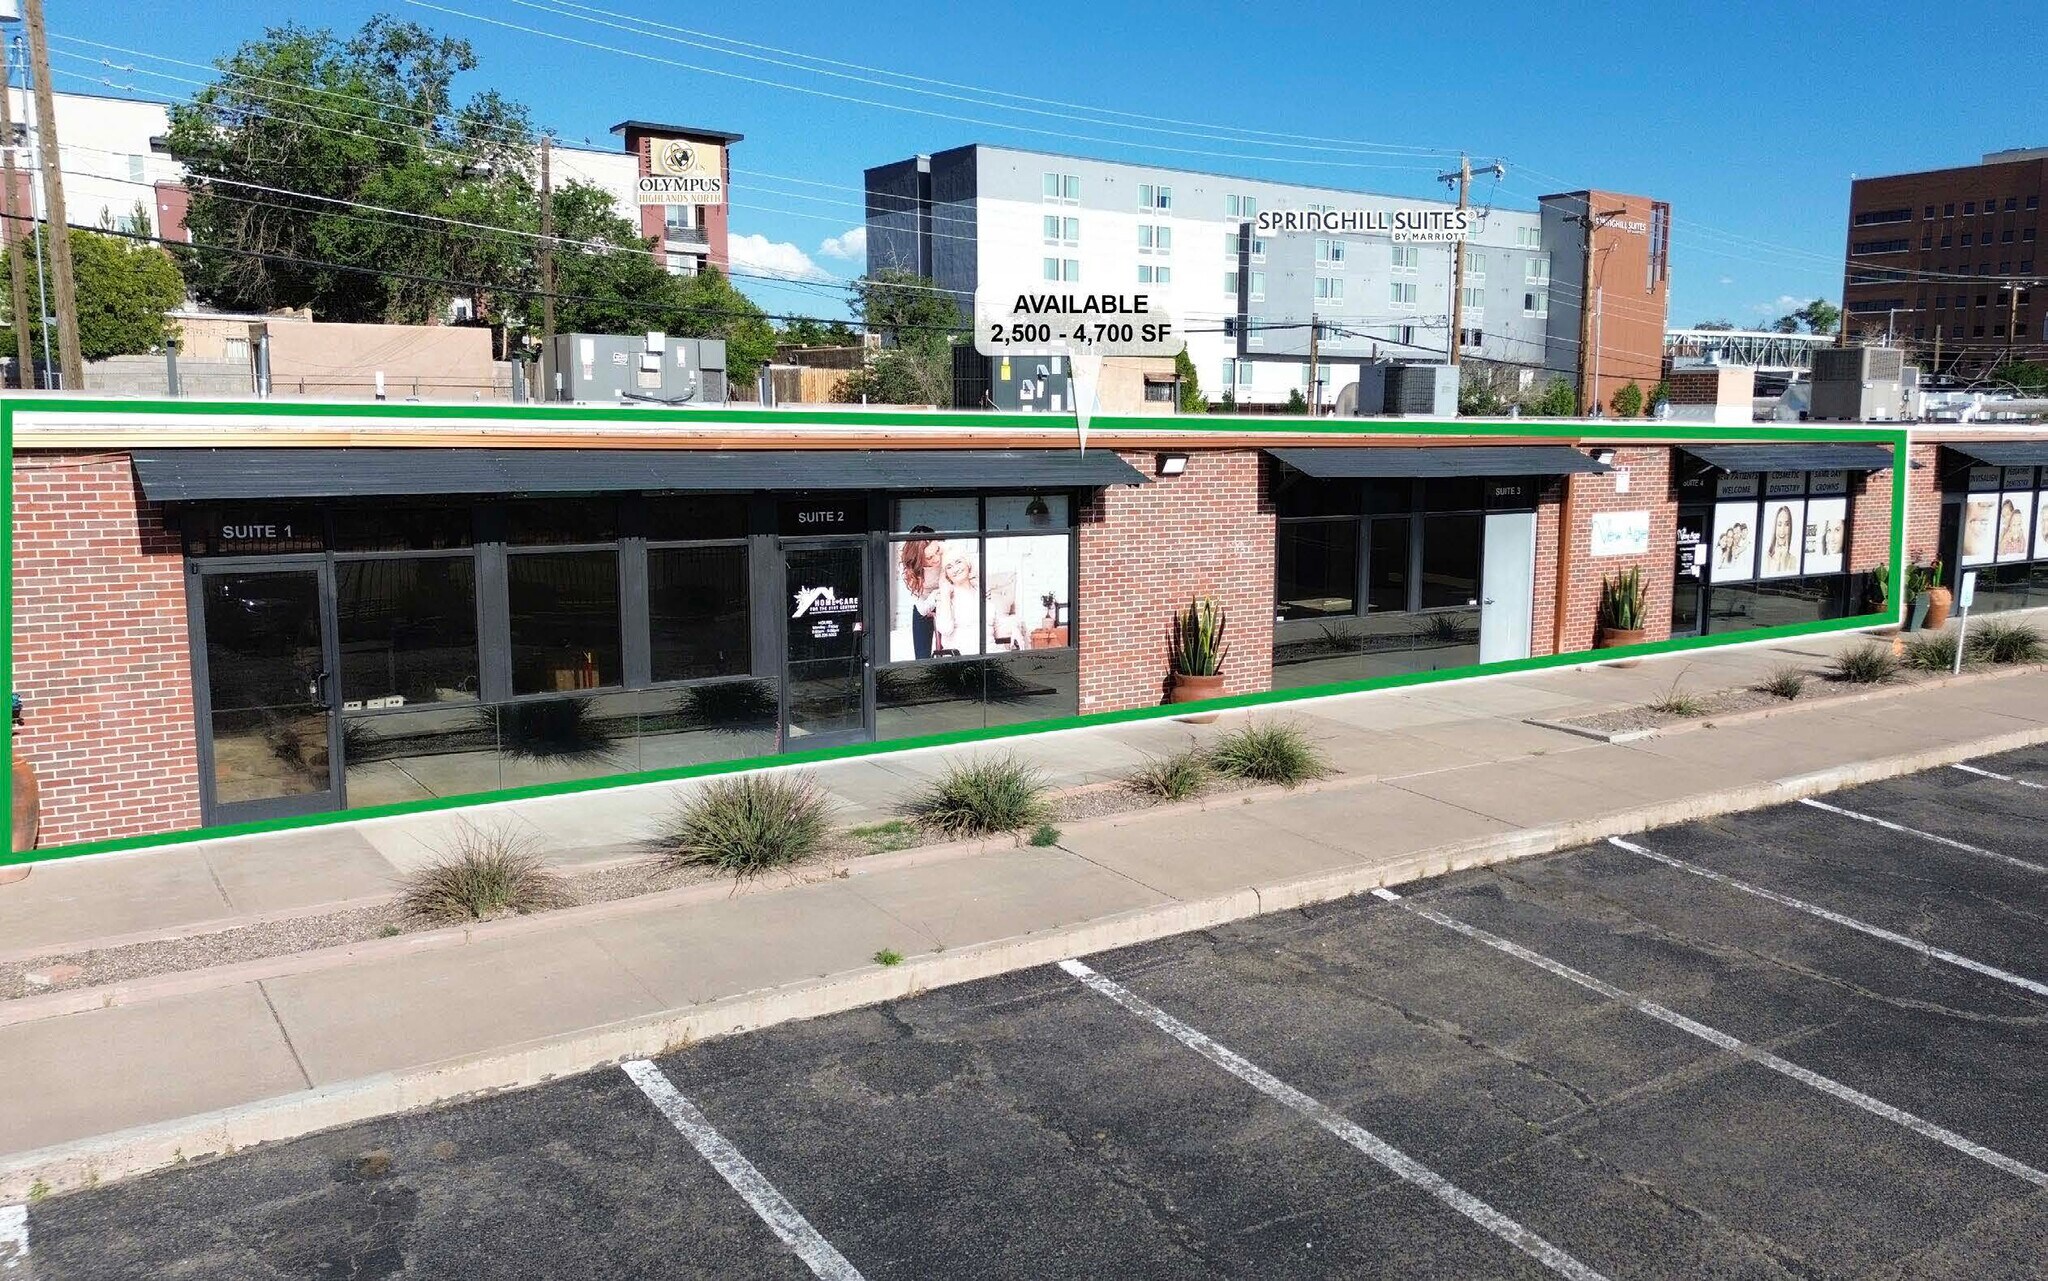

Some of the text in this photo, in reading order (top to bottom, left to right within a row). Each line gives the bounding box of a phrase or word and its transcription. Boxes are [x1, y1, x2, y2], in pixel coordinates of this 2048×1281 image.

[1495, 486, 1521, 496] SUITE 3
[1721, 485, 1751, 494] WELCOME
[1769, 484, 1801, 493] DENTISTRY
[798, 511, 845, 523] SUITE 2
[222, 524, 292, 539] SUITE 1
[814, 597, 859, 607] HOME CARE
